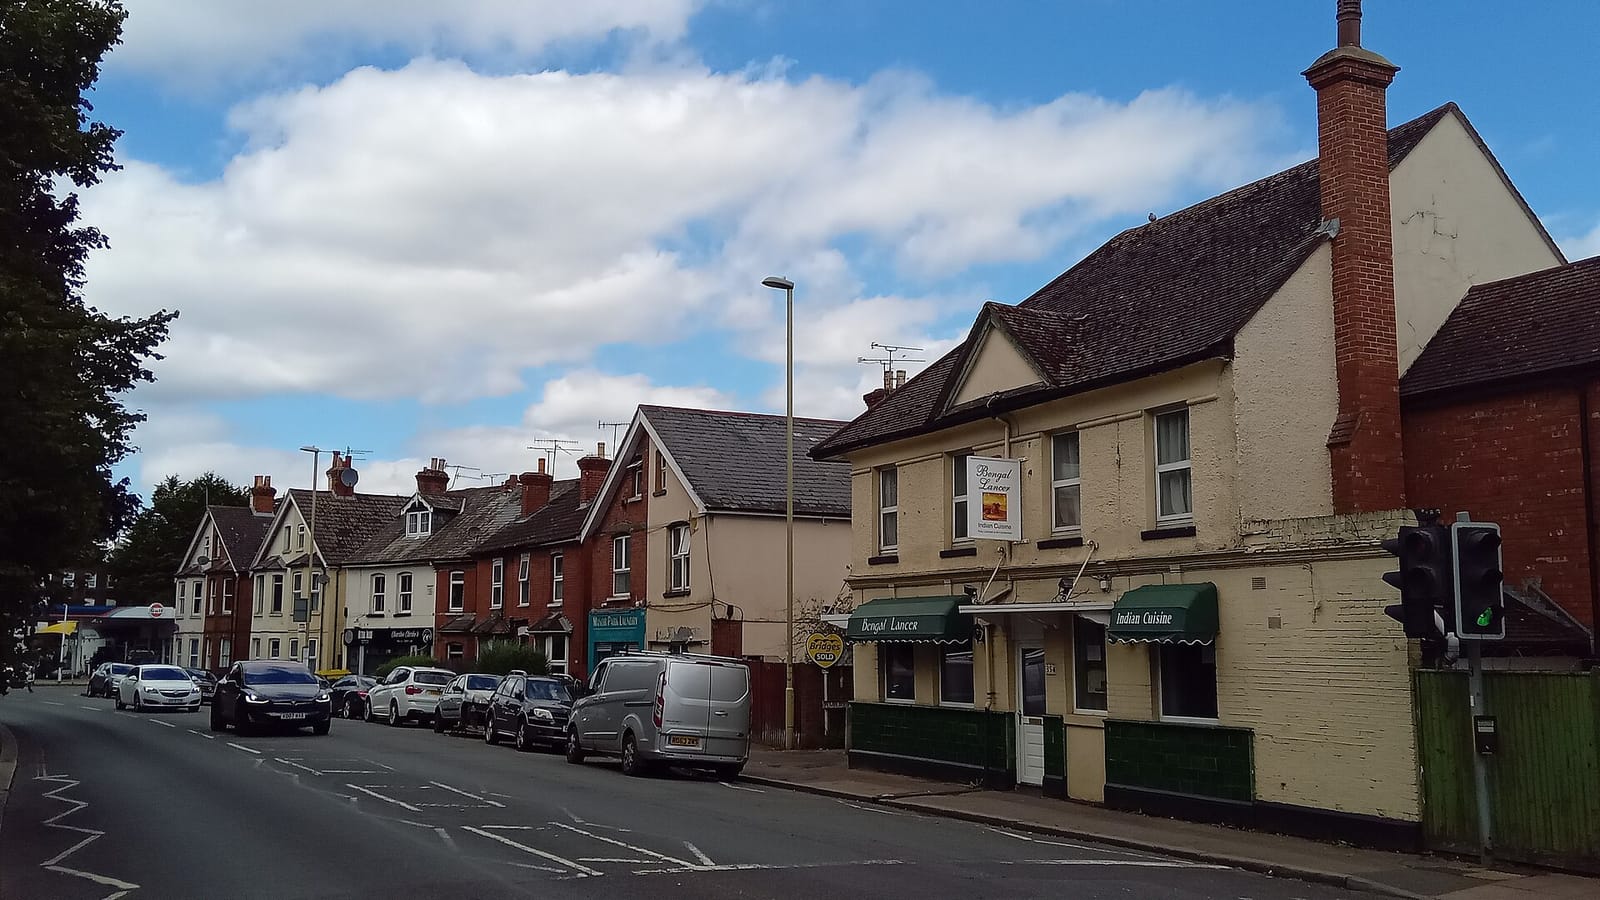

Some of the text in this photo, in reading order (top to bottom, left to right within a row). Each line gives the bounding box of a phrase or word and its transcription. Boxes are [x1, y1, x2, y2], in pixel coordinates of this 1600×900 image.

[976, 464, 1012, 483] Bengal
[979, 478, 1010, 492] Lancer
[1116, 611, 1173, 625] Indian Cuisine
[861, 618, 887, 635] Bengal
[810, 641, 840, 652] Bridges
[816, 653, 834, 661] SOLD
